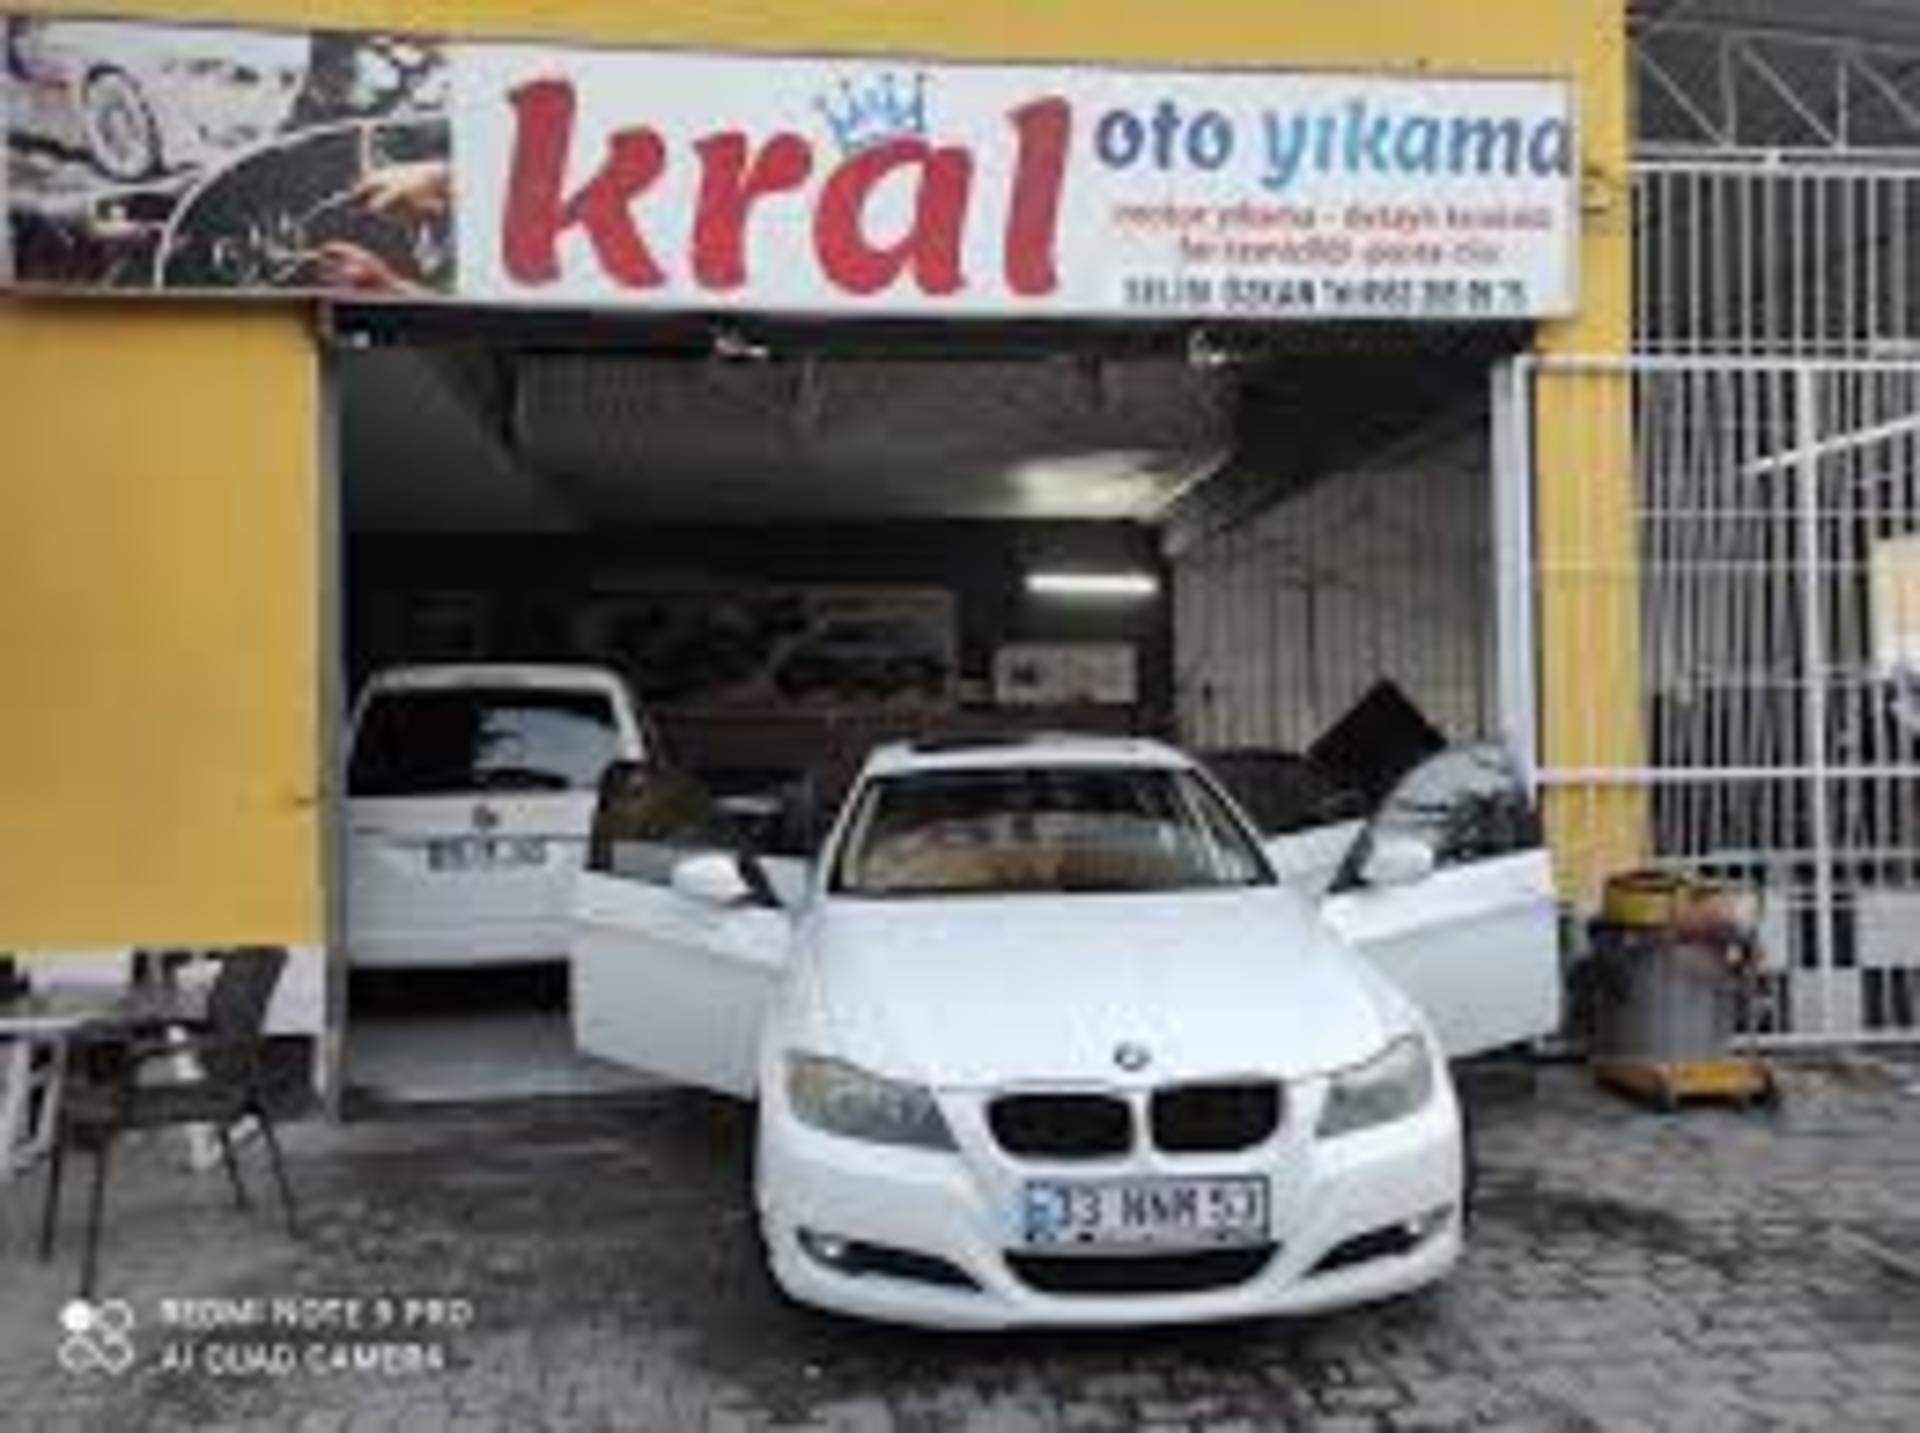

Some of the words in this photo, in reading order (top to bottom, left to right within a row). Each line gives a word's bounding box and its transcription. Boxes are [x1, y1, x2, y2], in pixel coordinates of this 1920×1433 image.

[501, 78, 1071, 295] kral
[1095, 98, 1233, 170] oto
[1260, 98, 1572, 190] yıkama
